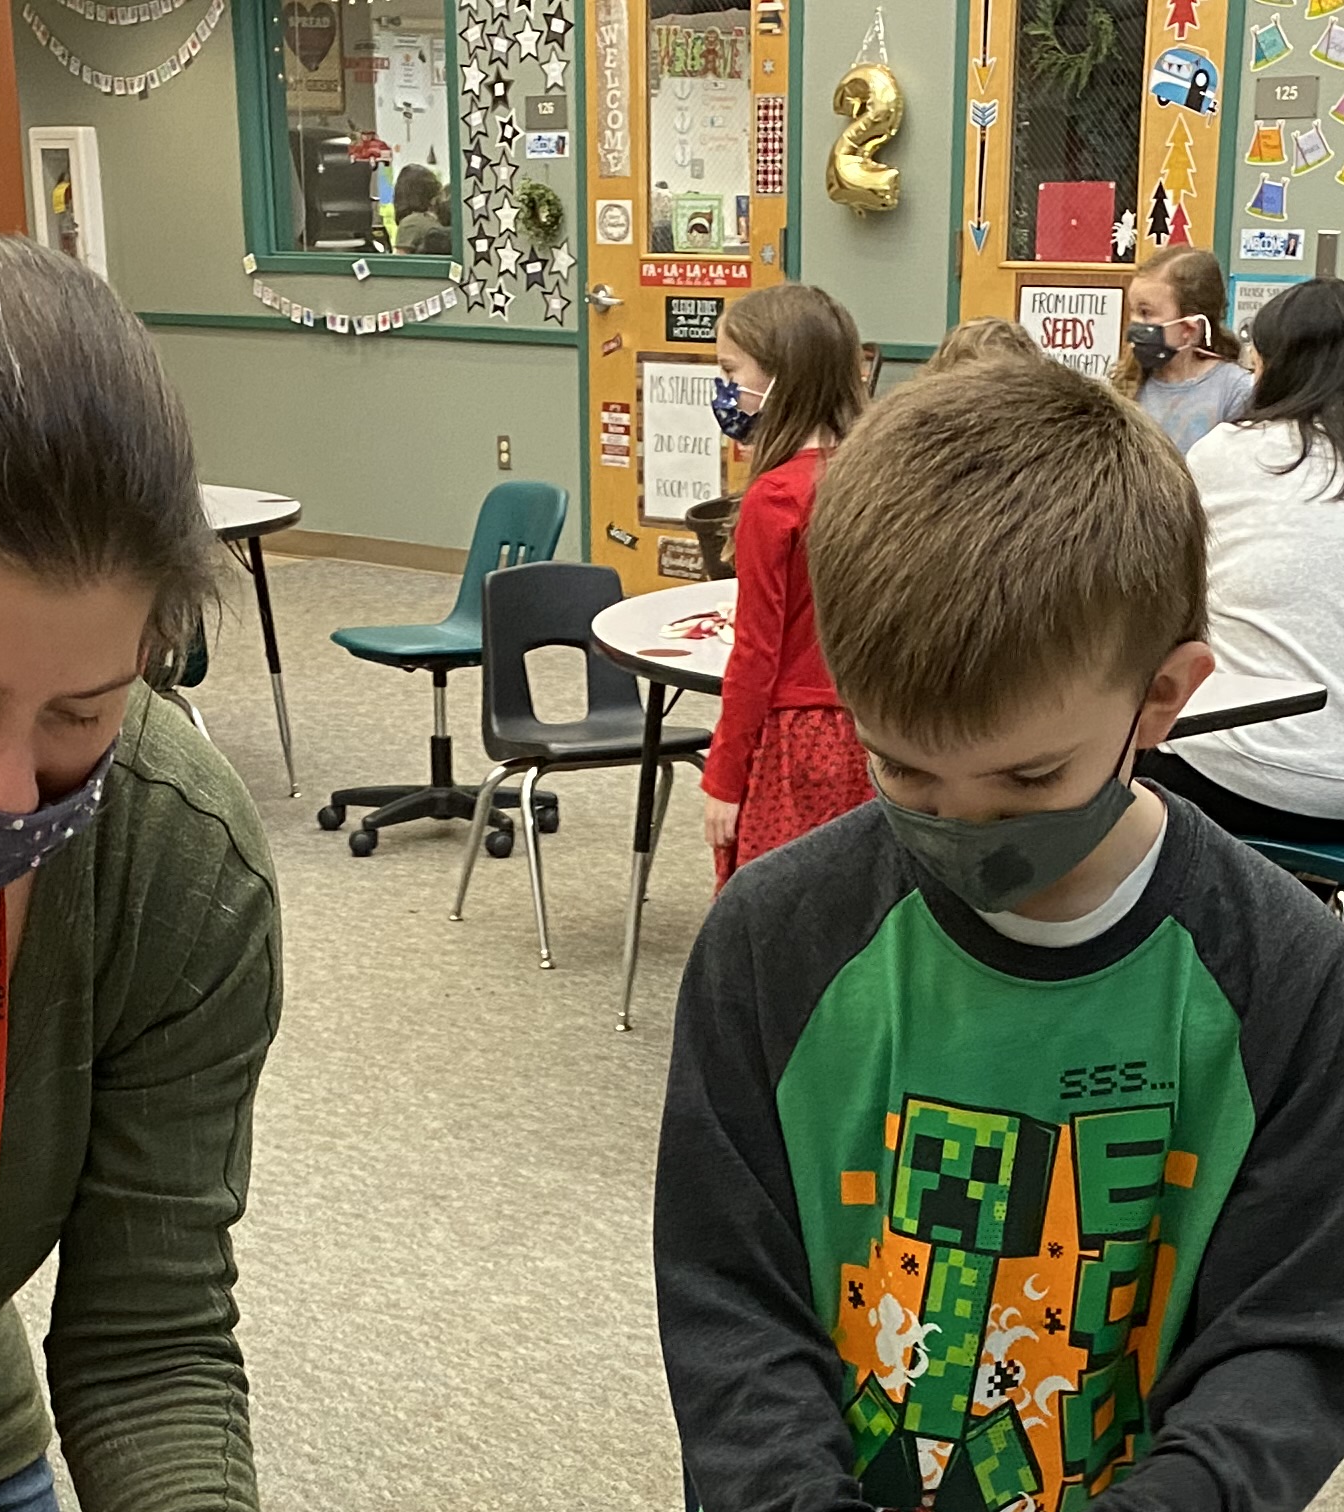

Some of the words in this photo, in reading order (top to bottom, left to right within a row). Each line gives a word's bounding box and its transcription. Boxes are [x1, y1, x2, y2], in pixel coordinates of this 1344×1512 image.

[599, 23, 623, 173] WELCOME
[1275, 86, 1298, 100] 125
[538, 102, 554, 115] 126
[1032, 292, 1066, 314] FROM
[1068, 293, 1108, 316] LITTLE
[1041, 316, 1095, 350] SEEDS
[1062, 353, 1111, 376] MIGHTY
[654, 433, 675, 453] 2ND
